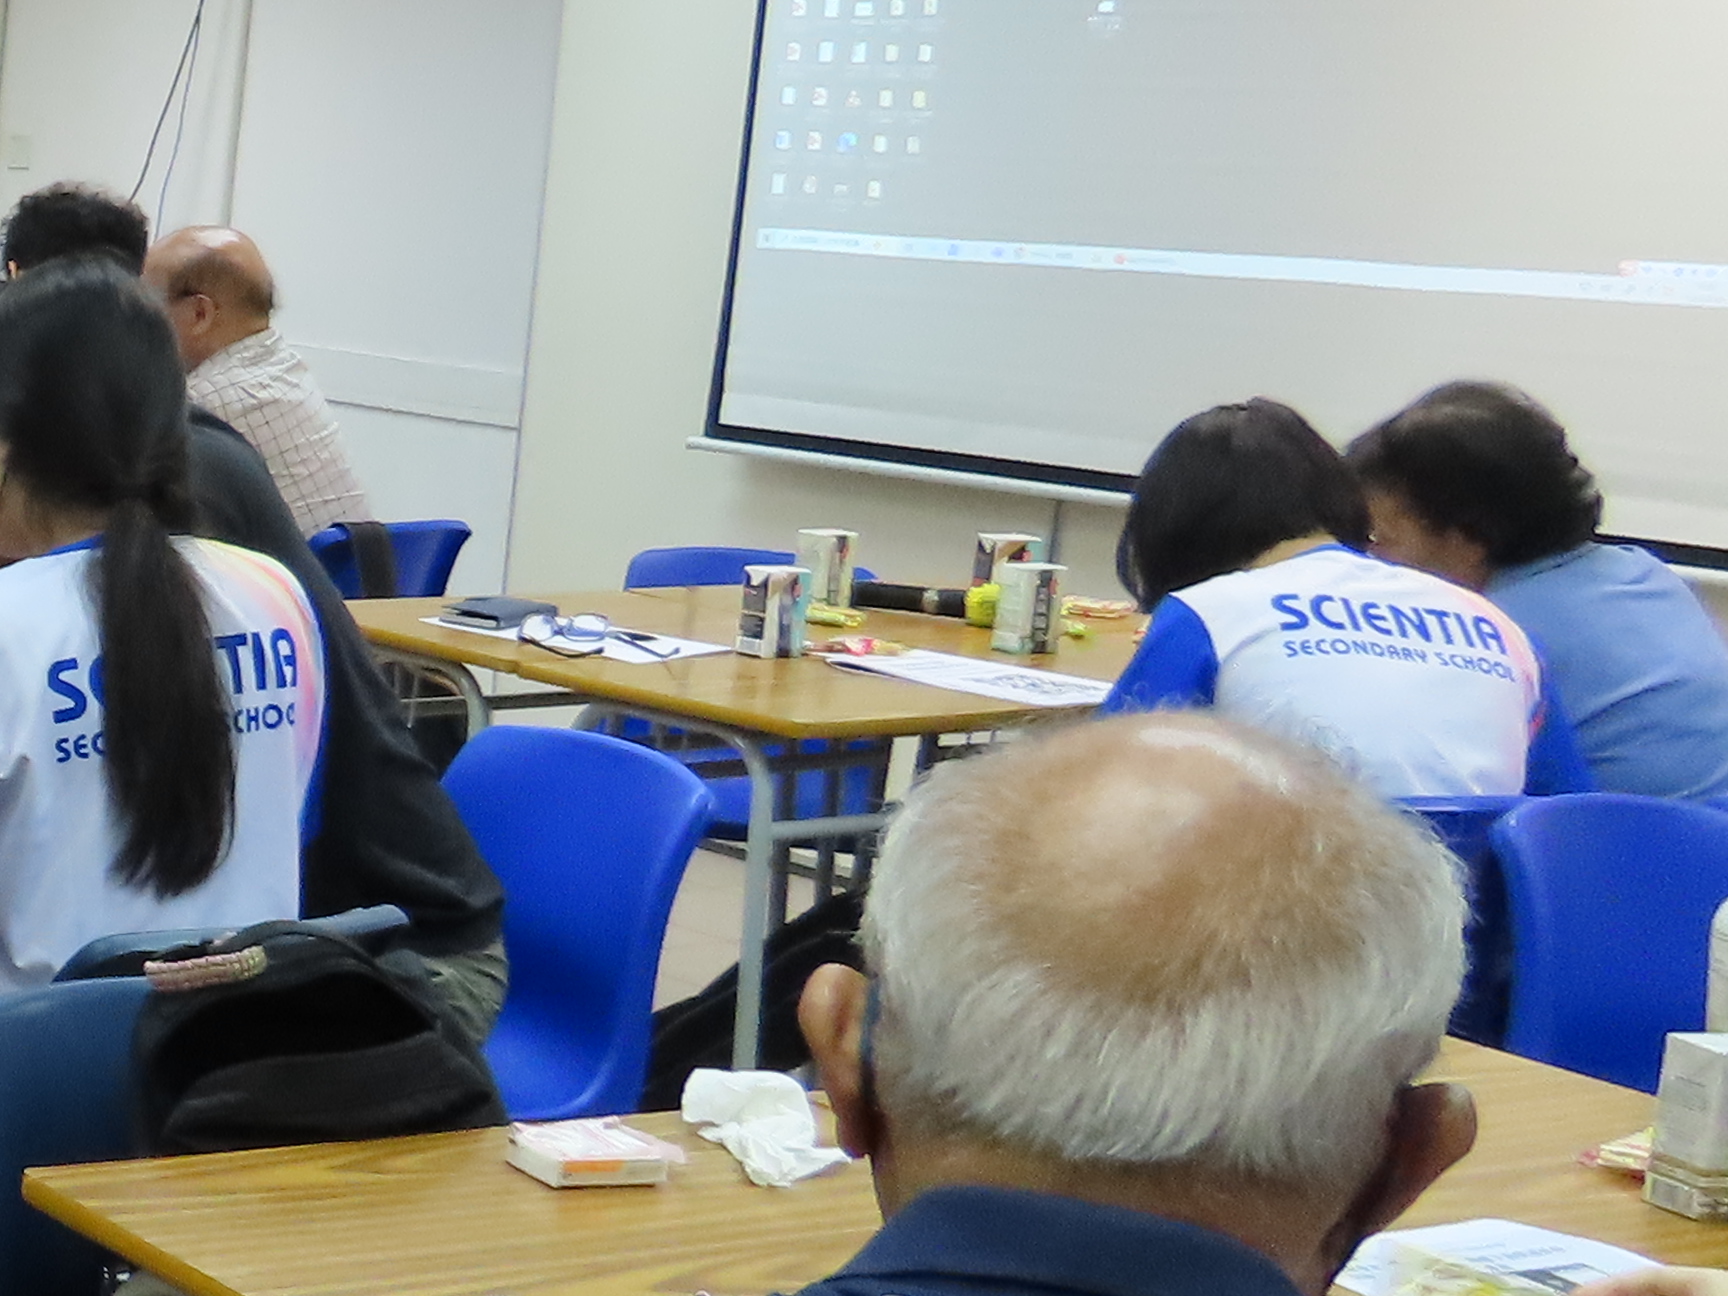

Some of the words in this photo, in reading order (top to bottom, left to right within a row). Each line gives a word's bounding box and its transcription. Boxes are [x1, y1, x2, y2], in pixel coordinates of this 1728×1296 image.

[1271, 593, 1509, 656] SCIENTIA
[1283, 638, 1429, 664] SECONDARY
[1435, 651, 1517, 683] SCHOOL
